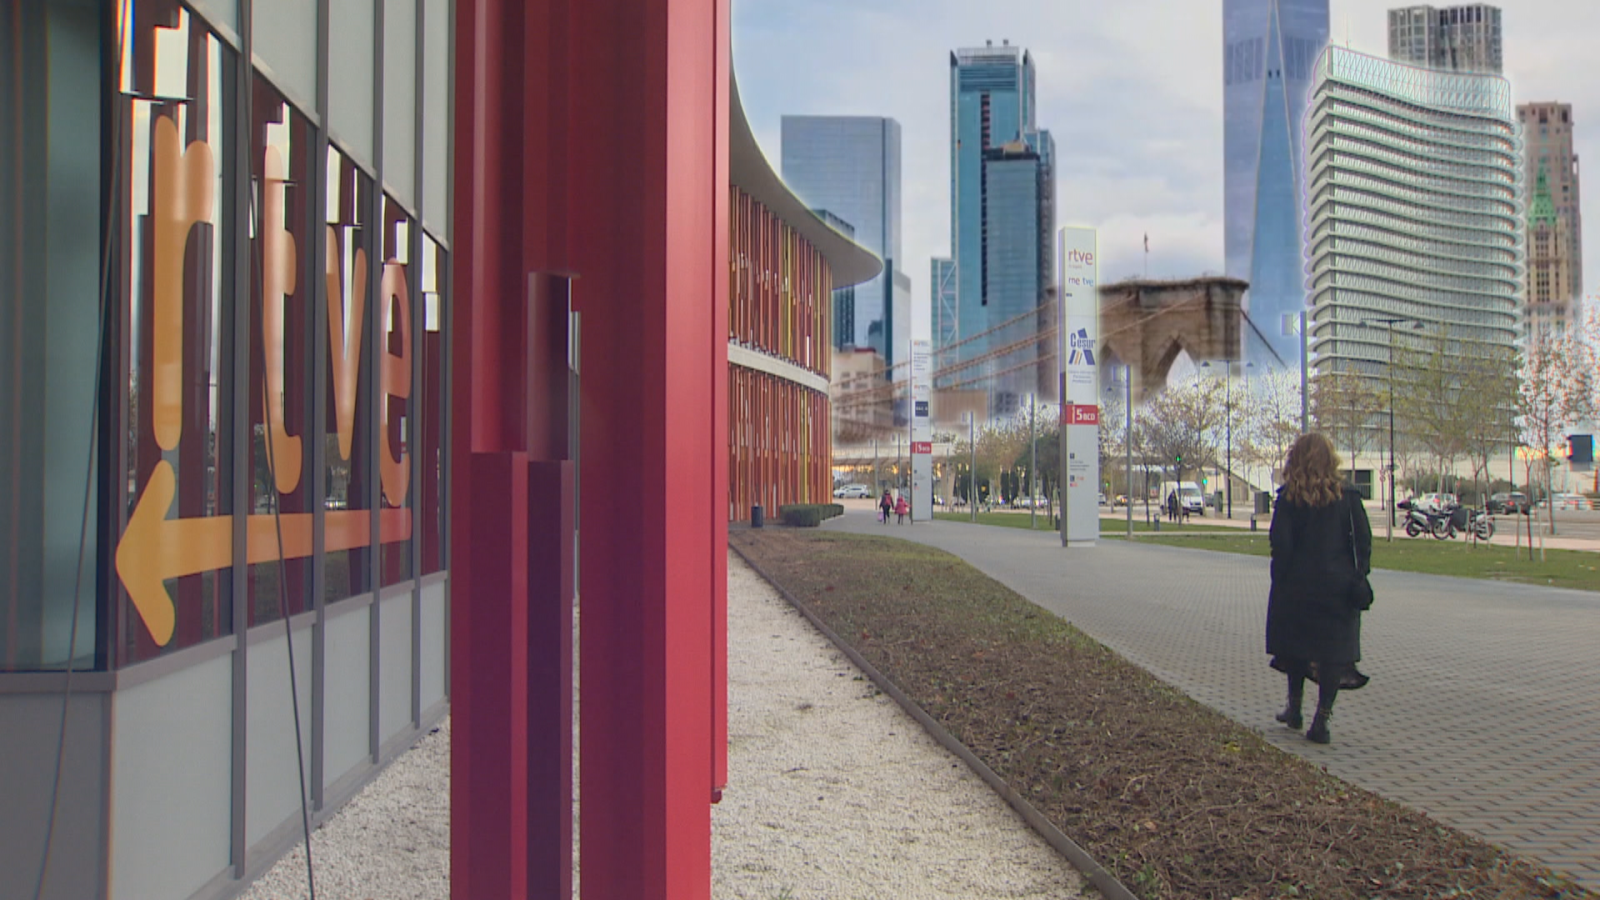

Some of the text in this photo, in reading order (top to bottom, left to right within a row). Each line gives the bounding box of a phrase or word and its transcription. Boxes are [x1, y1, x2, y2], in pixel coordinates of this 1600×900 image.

[1068, 248, 1093, 266] rtve
[1082, 276, 1094, 287] tve
[153, 115, 411, 507] rtve
[1069, 332, 1096, 349] Cesur
